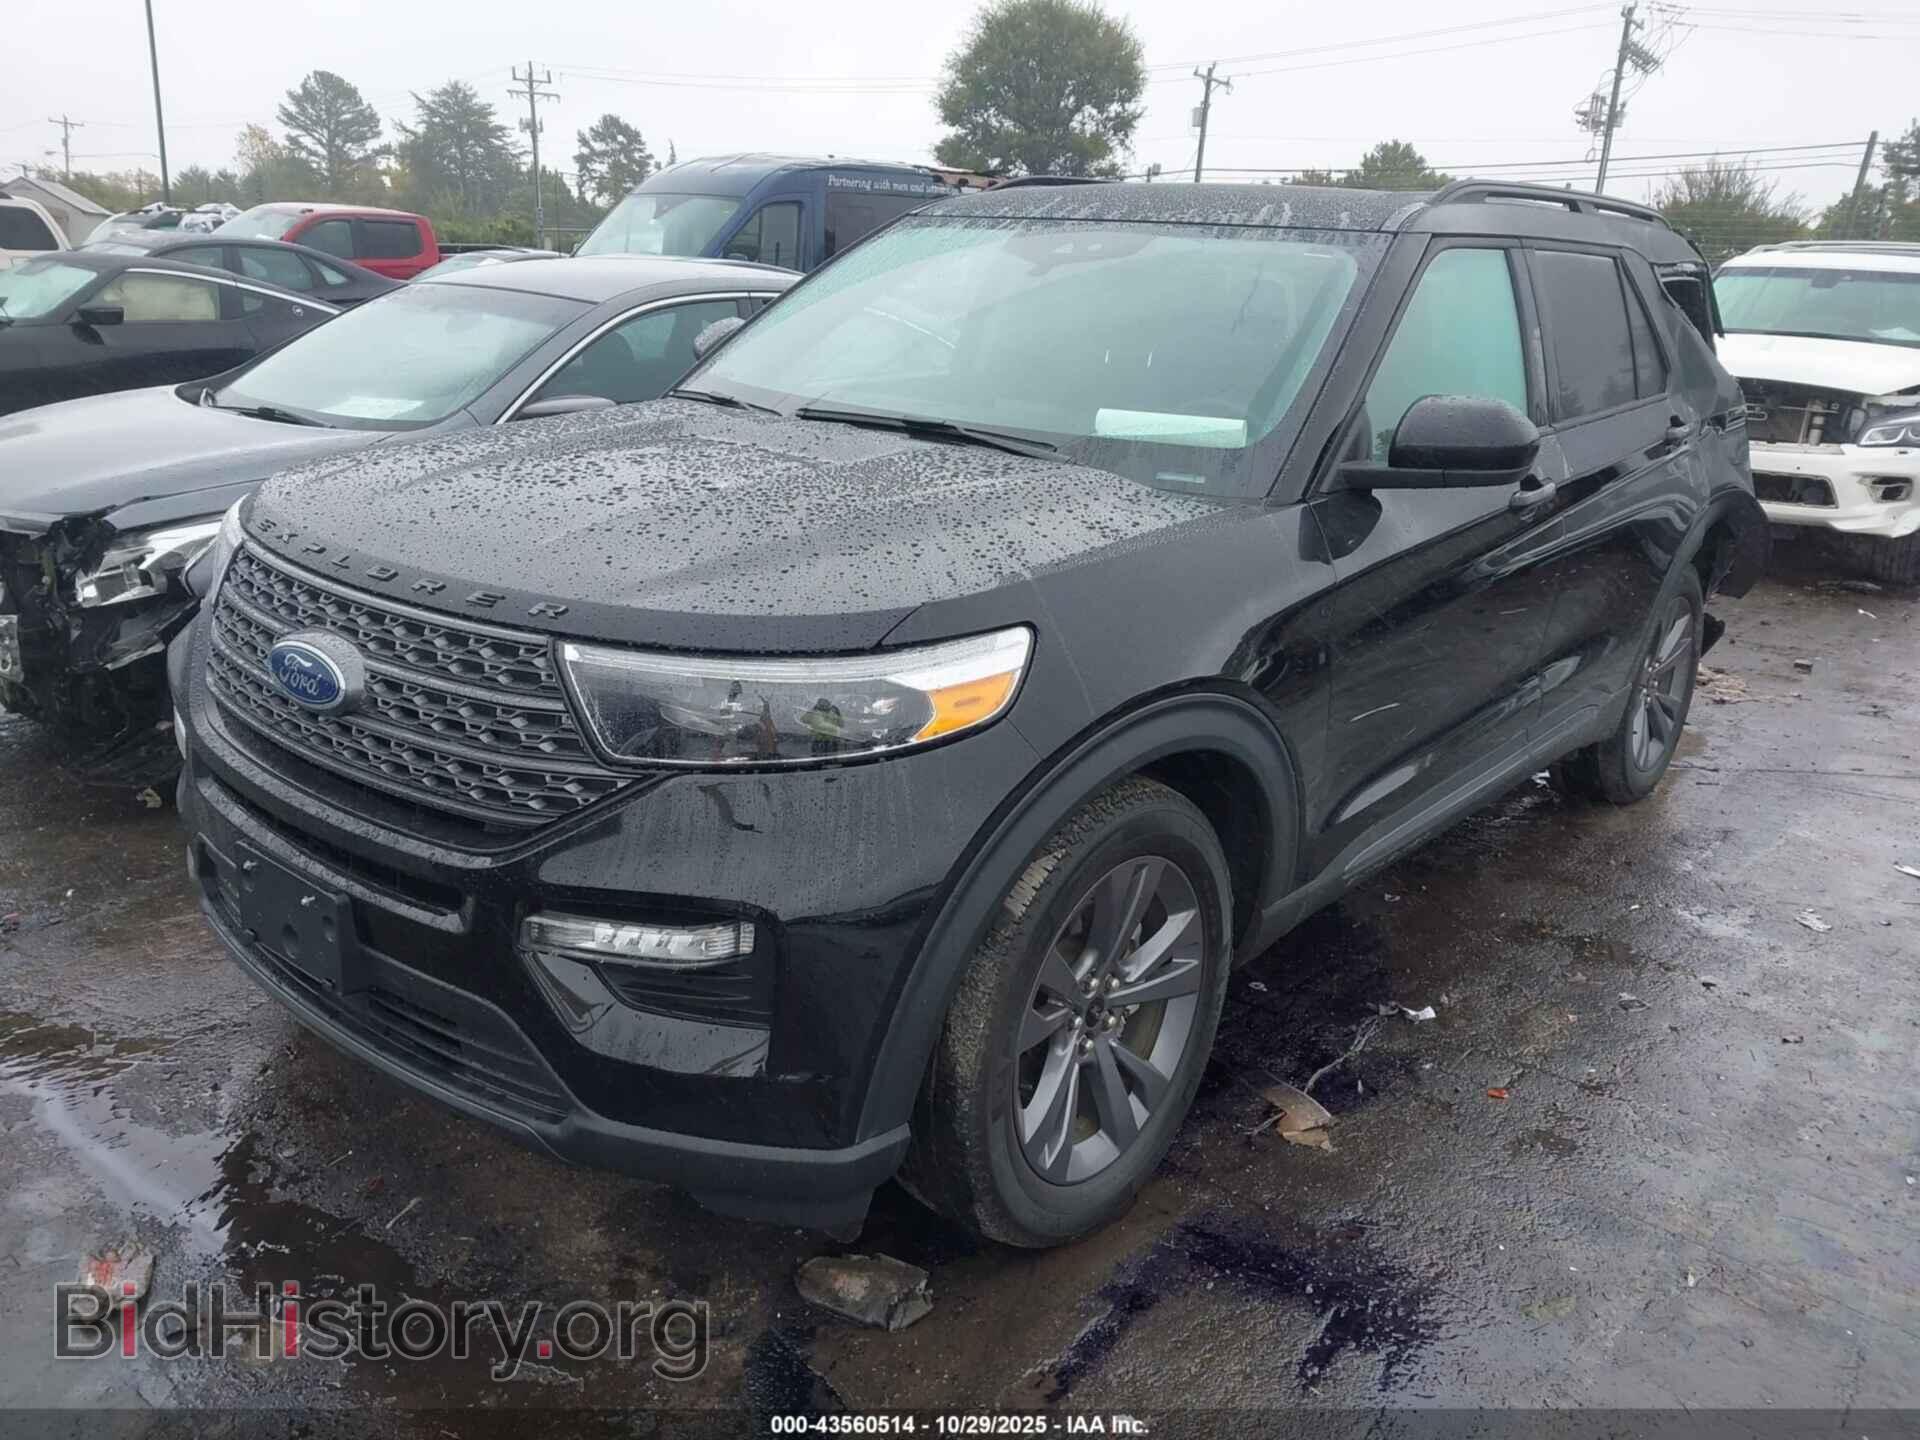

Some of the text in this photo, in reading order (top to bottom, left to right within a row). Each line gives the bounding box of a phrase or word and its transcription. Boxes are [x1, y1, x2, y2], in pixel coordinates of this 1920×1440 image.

[828, 174, 872, 190] Partnering
[874, 178, 891, 190] with
[910, 181, 925, 191] and
[258, 519, 569, 618] EXPLORER
[280, 653, 320, 695] Ford
